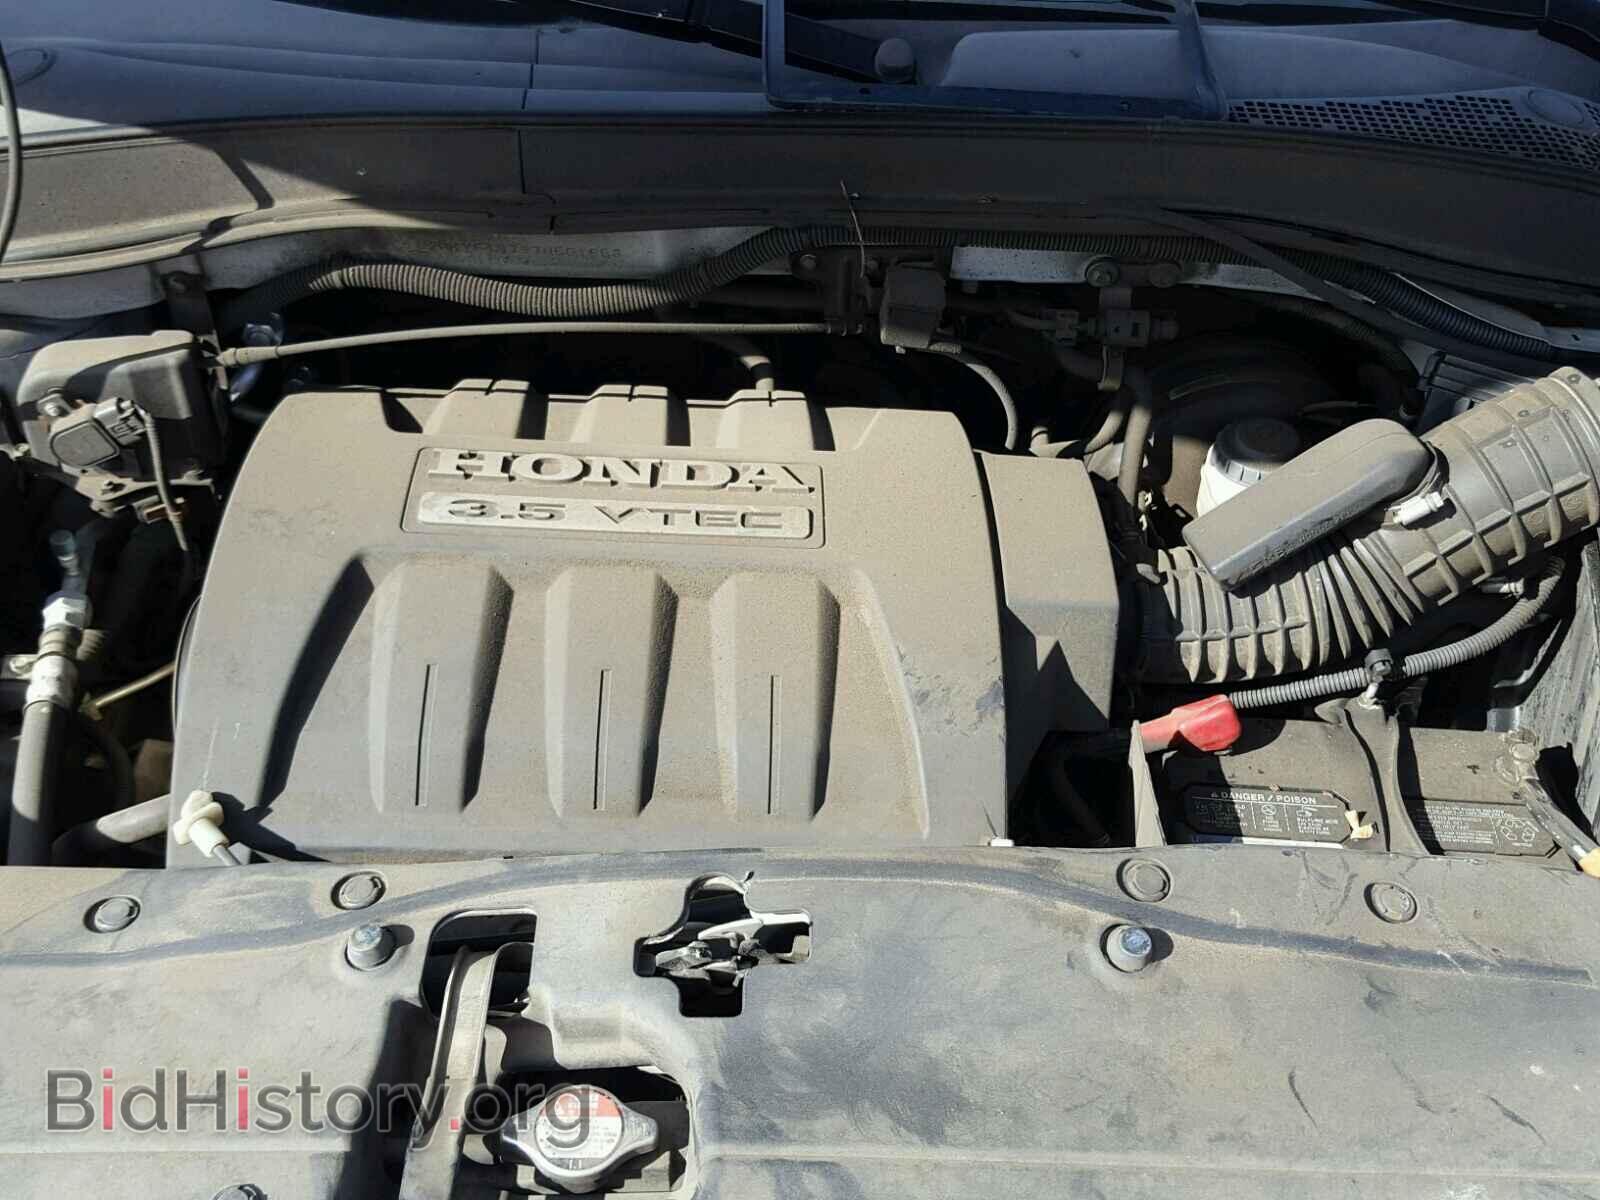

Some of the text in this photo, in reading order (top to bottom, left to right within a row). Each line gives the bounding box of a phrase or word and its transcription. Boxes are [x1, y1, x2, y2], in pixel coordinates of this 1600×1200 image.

[428, 447, 815, 494] HONDA
[448, 499, 783, 530] 3.5 VTEC
[1221, 791, 1266, 802] DANGER
[1276, 796, 1317, 805] POISON
